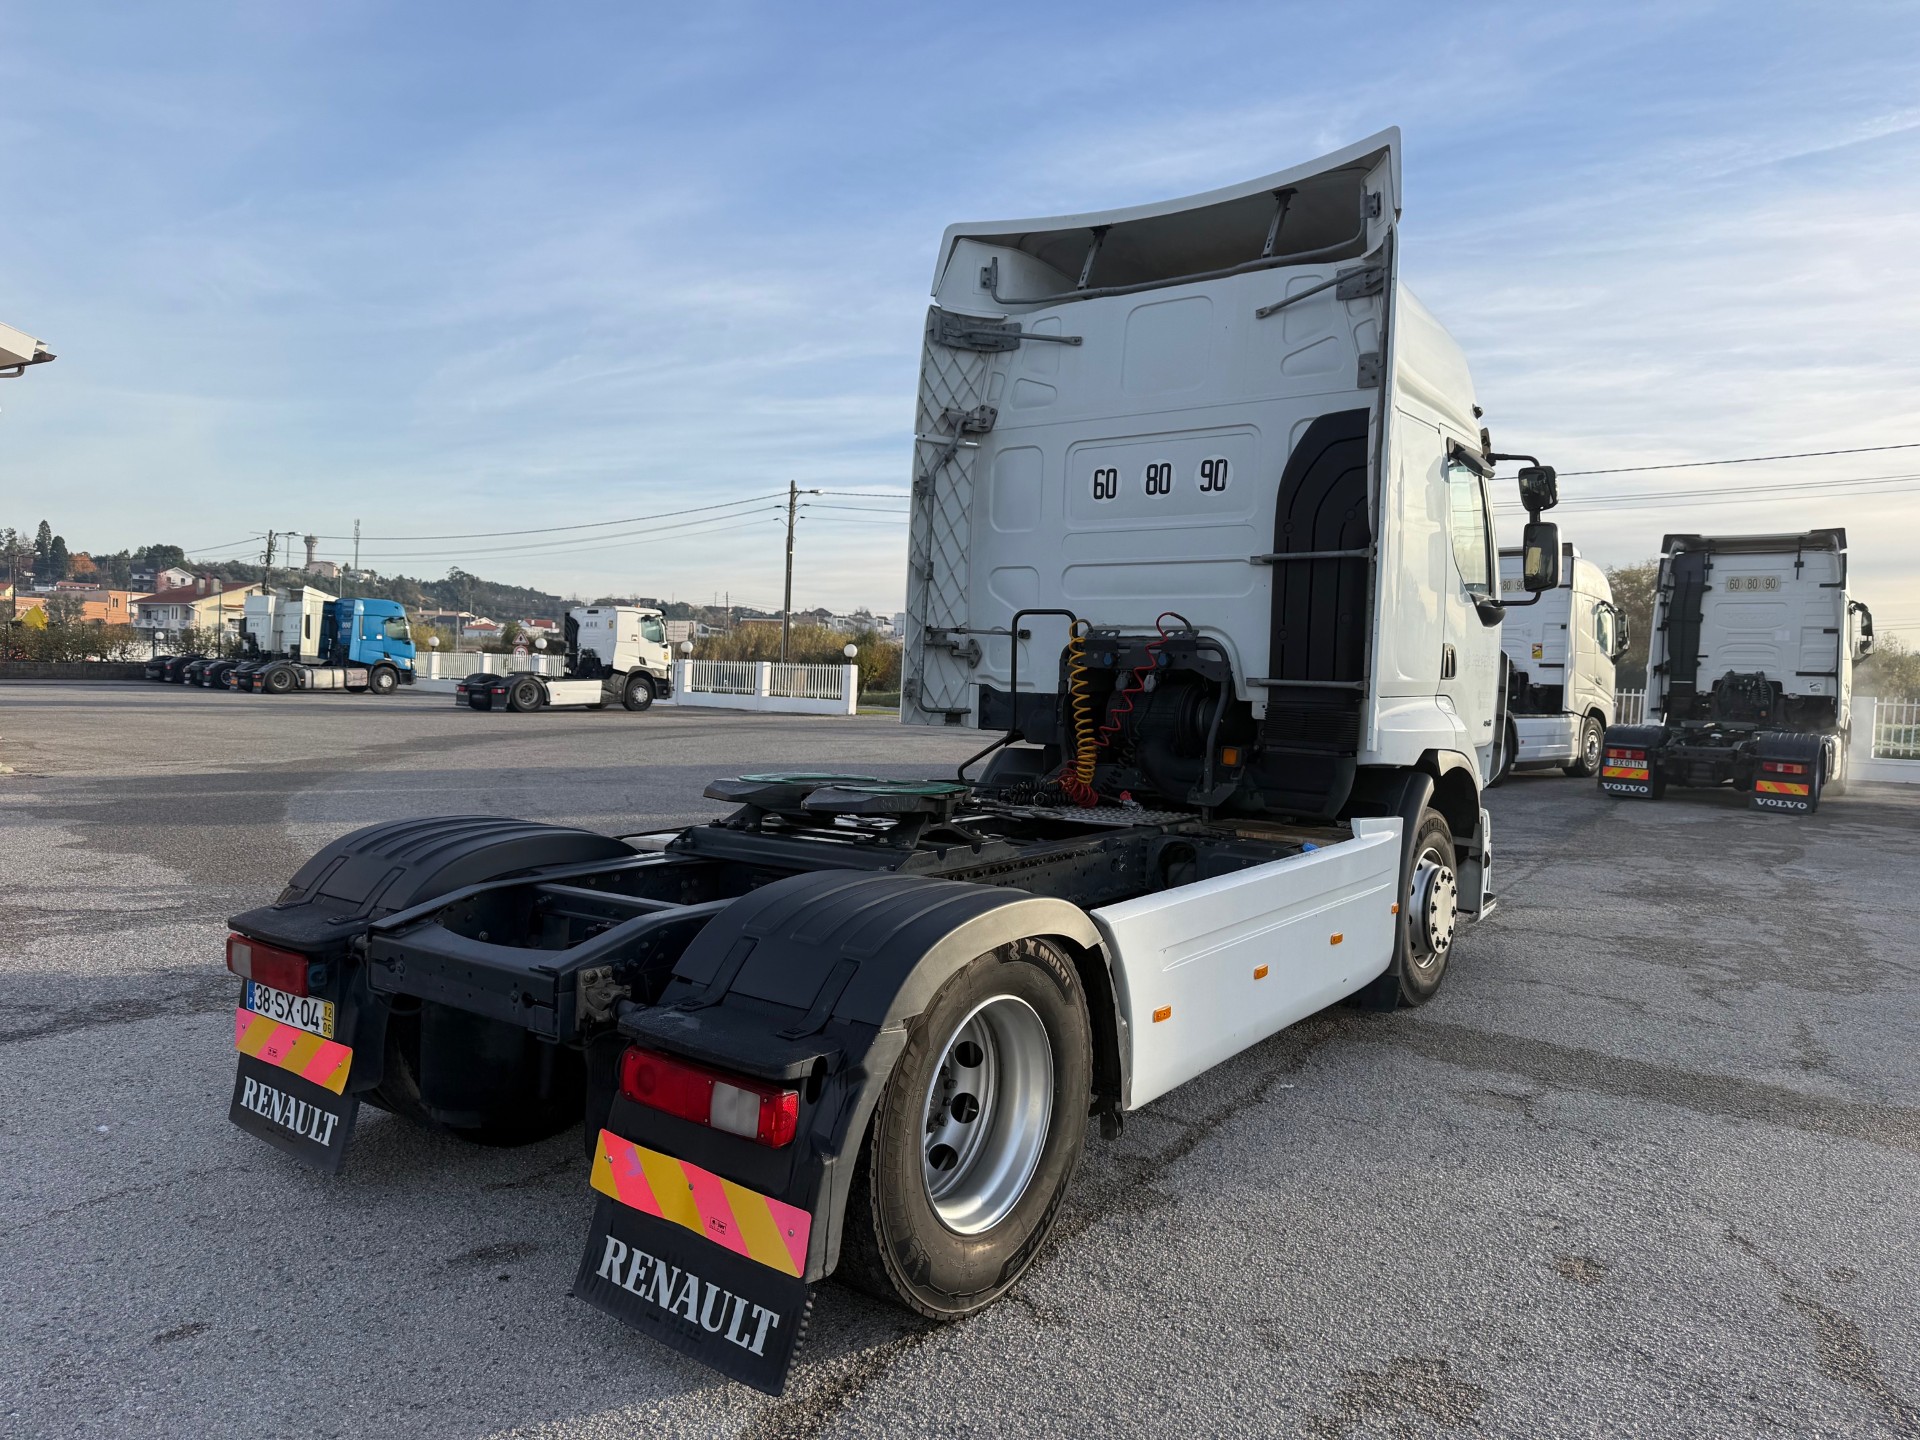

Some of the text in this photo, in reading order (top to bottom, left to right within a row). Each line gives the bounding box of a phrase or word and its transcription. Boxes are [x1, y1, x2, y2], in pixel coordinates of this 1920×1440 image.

[1093, 458, 1228, 500] 60 80 90
[1502, 580, 1511, 591] 80
[1729, 578, 1776, 590] 60 80 90
[1602, 782, 1648, 793] VOLVO
[1755, 797, 1808, 810] VOLVO
[1025, 938, 1071, 987] X MULTI
[324, 1006, 332, 1018] 12
[323, 1022, 332, 1034] 06
[240, 1075, 339, 1147] RENAULT
[596, 1234, 780, 1357] RENAULT
